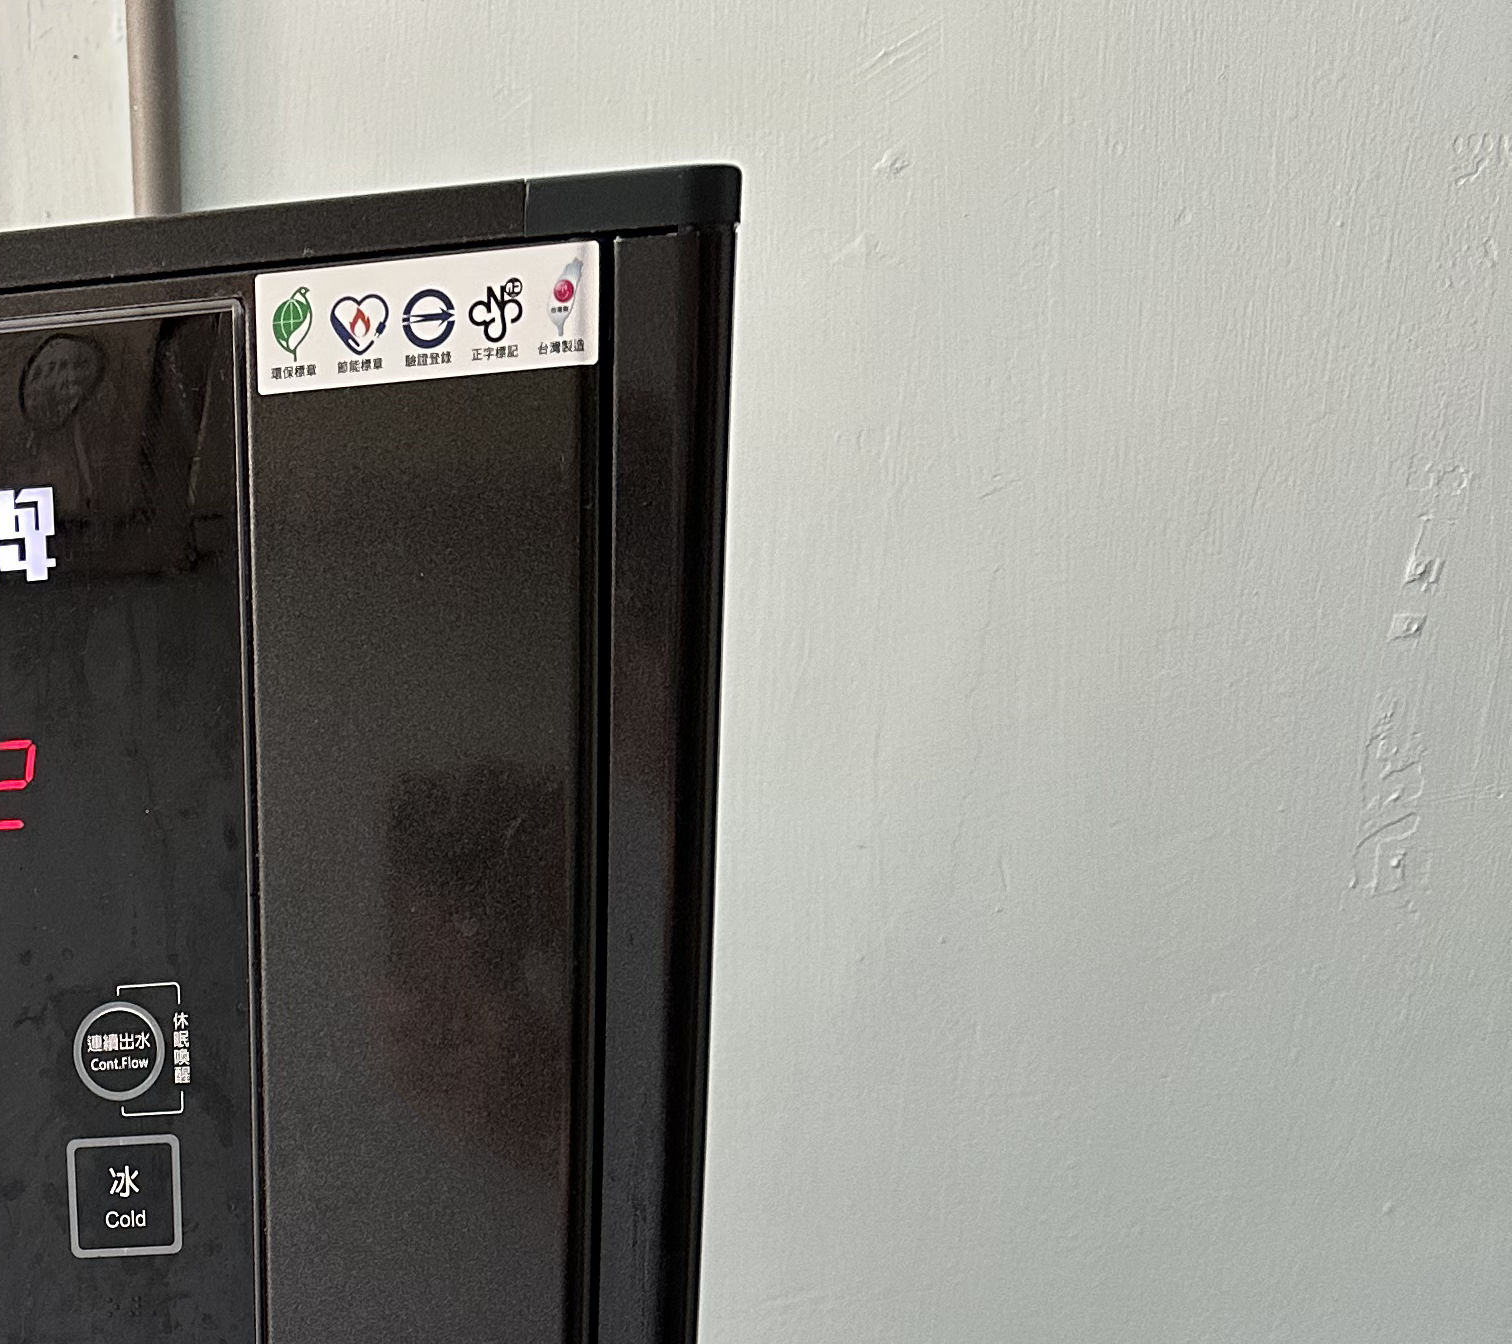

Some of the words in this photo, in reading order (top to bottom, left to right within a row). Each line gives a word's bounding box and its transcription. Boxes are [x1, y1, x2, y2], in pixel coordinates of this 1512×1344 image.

[471, 344, 519, 361] 正字標記
[537, 338, 585, 355] 台灣製造
[271, 364, 317, 380] 環保標章
[337, 357, 383, 374] 節能標章
[86, 1031, 151, 1053] 連續出水
[172, 1011, 191, 1084] 休眠喚醒
[90, 1055, 149, 1071] Cont.Flow
[108, 1164, 141, 1199] 冰
[105, 1209, 147, 1230] Cold
